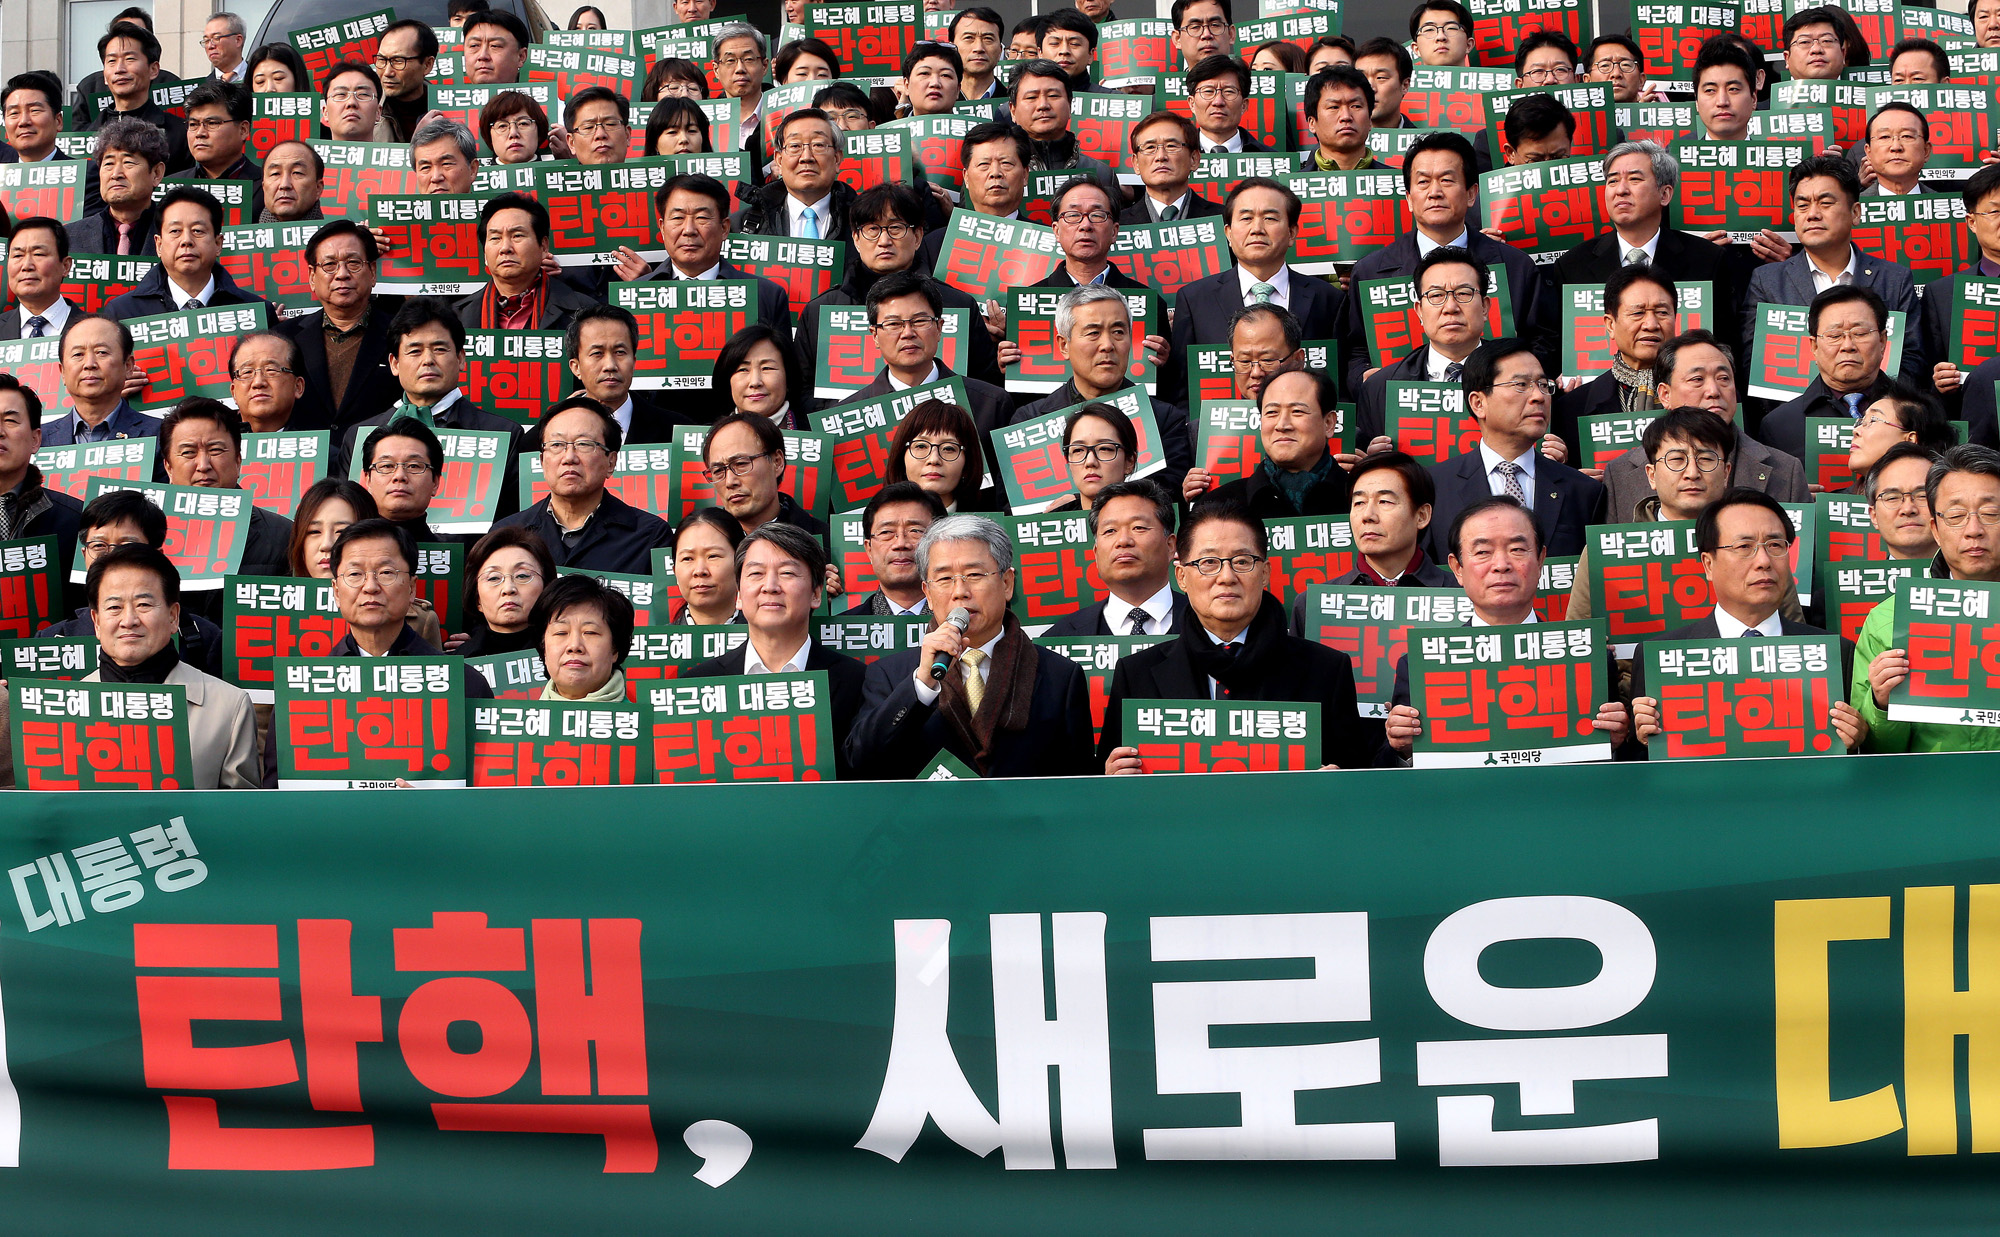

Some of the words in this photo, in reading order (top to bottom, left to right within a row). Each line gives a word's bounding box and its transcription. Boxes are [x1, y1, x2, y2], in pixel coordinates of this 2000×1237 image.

[812, 6, 861, 26] 박근혜
[867, 4, 915, 24] 대통령
[1637, 4, 1684, 24] 박근혜
[1690, 6, 1735, 28] 대통령
[1901, 9, 1934, 28] 근혜
[1937, 13, 1975, 36] 대통령
[296, 26, 341, 50] 박근혜
[343, 13, 389, 40] 대통령
[548, 33, 585, 47] 박근혜
[588, 32, 625, 47] 대통령
[1101, 19, 1136, 39] 박근혜
[1238, 21, 1278, 43] 박근혜
[1282, 15, 1329, 37] 대통령
[663, 41, 707, 59] 박근혜
[530, 48, 581, 70] 박근혜
[586, 54, 636, 78] 대통령
[1947, 52, 1998, 74] 박근혜
[1459, 71, 1513, 92] 대통령
[264, 97, 312, 116] 대통령
[437, 88, 490, 107] 박근혜
[768, 86, 804, 109] 박근혜
[1553, 87, 1606, 109] 대통령
[1777, 86, 1828, 105] 박근혜
[1835, 85, 1867, 106] 대통
[1936, 89, 1987, 110] 대통령
[1090, 98, 1143, 119] 대통령
[1639, 107, 1692, 127] 대통령
[1769, 112, 1824, 134] 대통령
[313, 144, 366, 166] 박근혜
[847, 133, 902, 155] 대통령
[1679, 145, 1738, 167] 박근혜
[1746, 146, 1803, 168] 대통령
[28, 164, 78, 186] 대통령
[686, 156, 741, 178] 대통령
[1193, 158, 1229, 179] 근혜
[1236, 157, 1291, 178] 대통령
[1487, 164, 1543, 194] 박근혜
[1549, 159, 1606, 186] 대통령
[1927, 169, 1956, 180] 국민의당
[471, 169, 508, 192] 근혜
[547, 172, 601, 194] 박근혜
[610, 166, 666, 189] 대통령
[1289, 175, 1348, 199] 박근혜
[377, 199, 432, 221] 박근혜
[1489, 189, 1615, 249] 탄핵!
[1913, 198, 1969, 220] 대통령
[222, 228, 275, 251] 박근혜
[958, 212, 1016, 245] 박근혜
[1158, 221, 1216, 247] 대통령
[378, 222, 493, 277] 탄핵
[777, 242, 835, 267] 대통령
[430, 284, 461, 297] 국민의당
[618, 286, 678, 310] 박근혜
[686, 285, 747, 308] 대통령
[129, 316, 190, 344] 박근혜
[196, 308, 257, 335] 대통령
[503, 335, 563, 358] 대통령
[133, 335, 241, 405] 탄핵
[673, 374, 706, 386] 국민의당
[1398, 388, 1464, 413] 박근혜
[821, 403, 887, 437] 박근혜
[85, 444, 145, 469] 대통령
[256, 436, 319, 459] 대통령
[173, 492, 242, 518] 대통령
[1016, 517, 1088, 547] 박근혜
[1305, 521, 1353, 548] 대통
[1600, 529, 1676, 559] 박근혜
[236, 583, 306, 611] 박근혜
[1320, 592, 1395, 621] 박근혜
[1909, 586, 1990, 619] 박근혜
[628, 633, 692, 660] 박근혜
[820, 622, 895, 650] 박근혜
[1421, 634, 1502, 665] 박근혜
[1514, 627, 1592, 660] 대통령
[14, 644, 86, 672] 박근혜
[1658, 646, 1739, 677] 박근혜
[1750, 643, 1828, 674] 대통령
[286, 664, 362, 693] 박근혜
[373, 664, 450, 693] 대통령
[20, 687, 90, 718] 박근혜
[100, 691, 174, 720] 대통령
[650, 684, 727, 716] 박근혜
[738, 679, 816, 711] 대통령
[1424, 662, 1596, 744] 탄핵!
[475, 707, 551, 737] 박근혜
[562, 709, 639, 740] 대통령
[1137, 708, 1216, 737] 박근혜
[1228, 709, 1307, 739] 대통령
[1661, 677, 1832, 758] 탄핵!
[288, 696, 451, 772] 탄핵!
[22, 720, 180, 792] 탄핵!
[652, 713, 821, 785] 탄핵!
[1500, 750, 1542, 768] 국민의당
[7, 815, 209, 933] 대통령
[133, 911, 753, 1188] 탄핵,
[854, 894, 1669, 1170] 새로운
